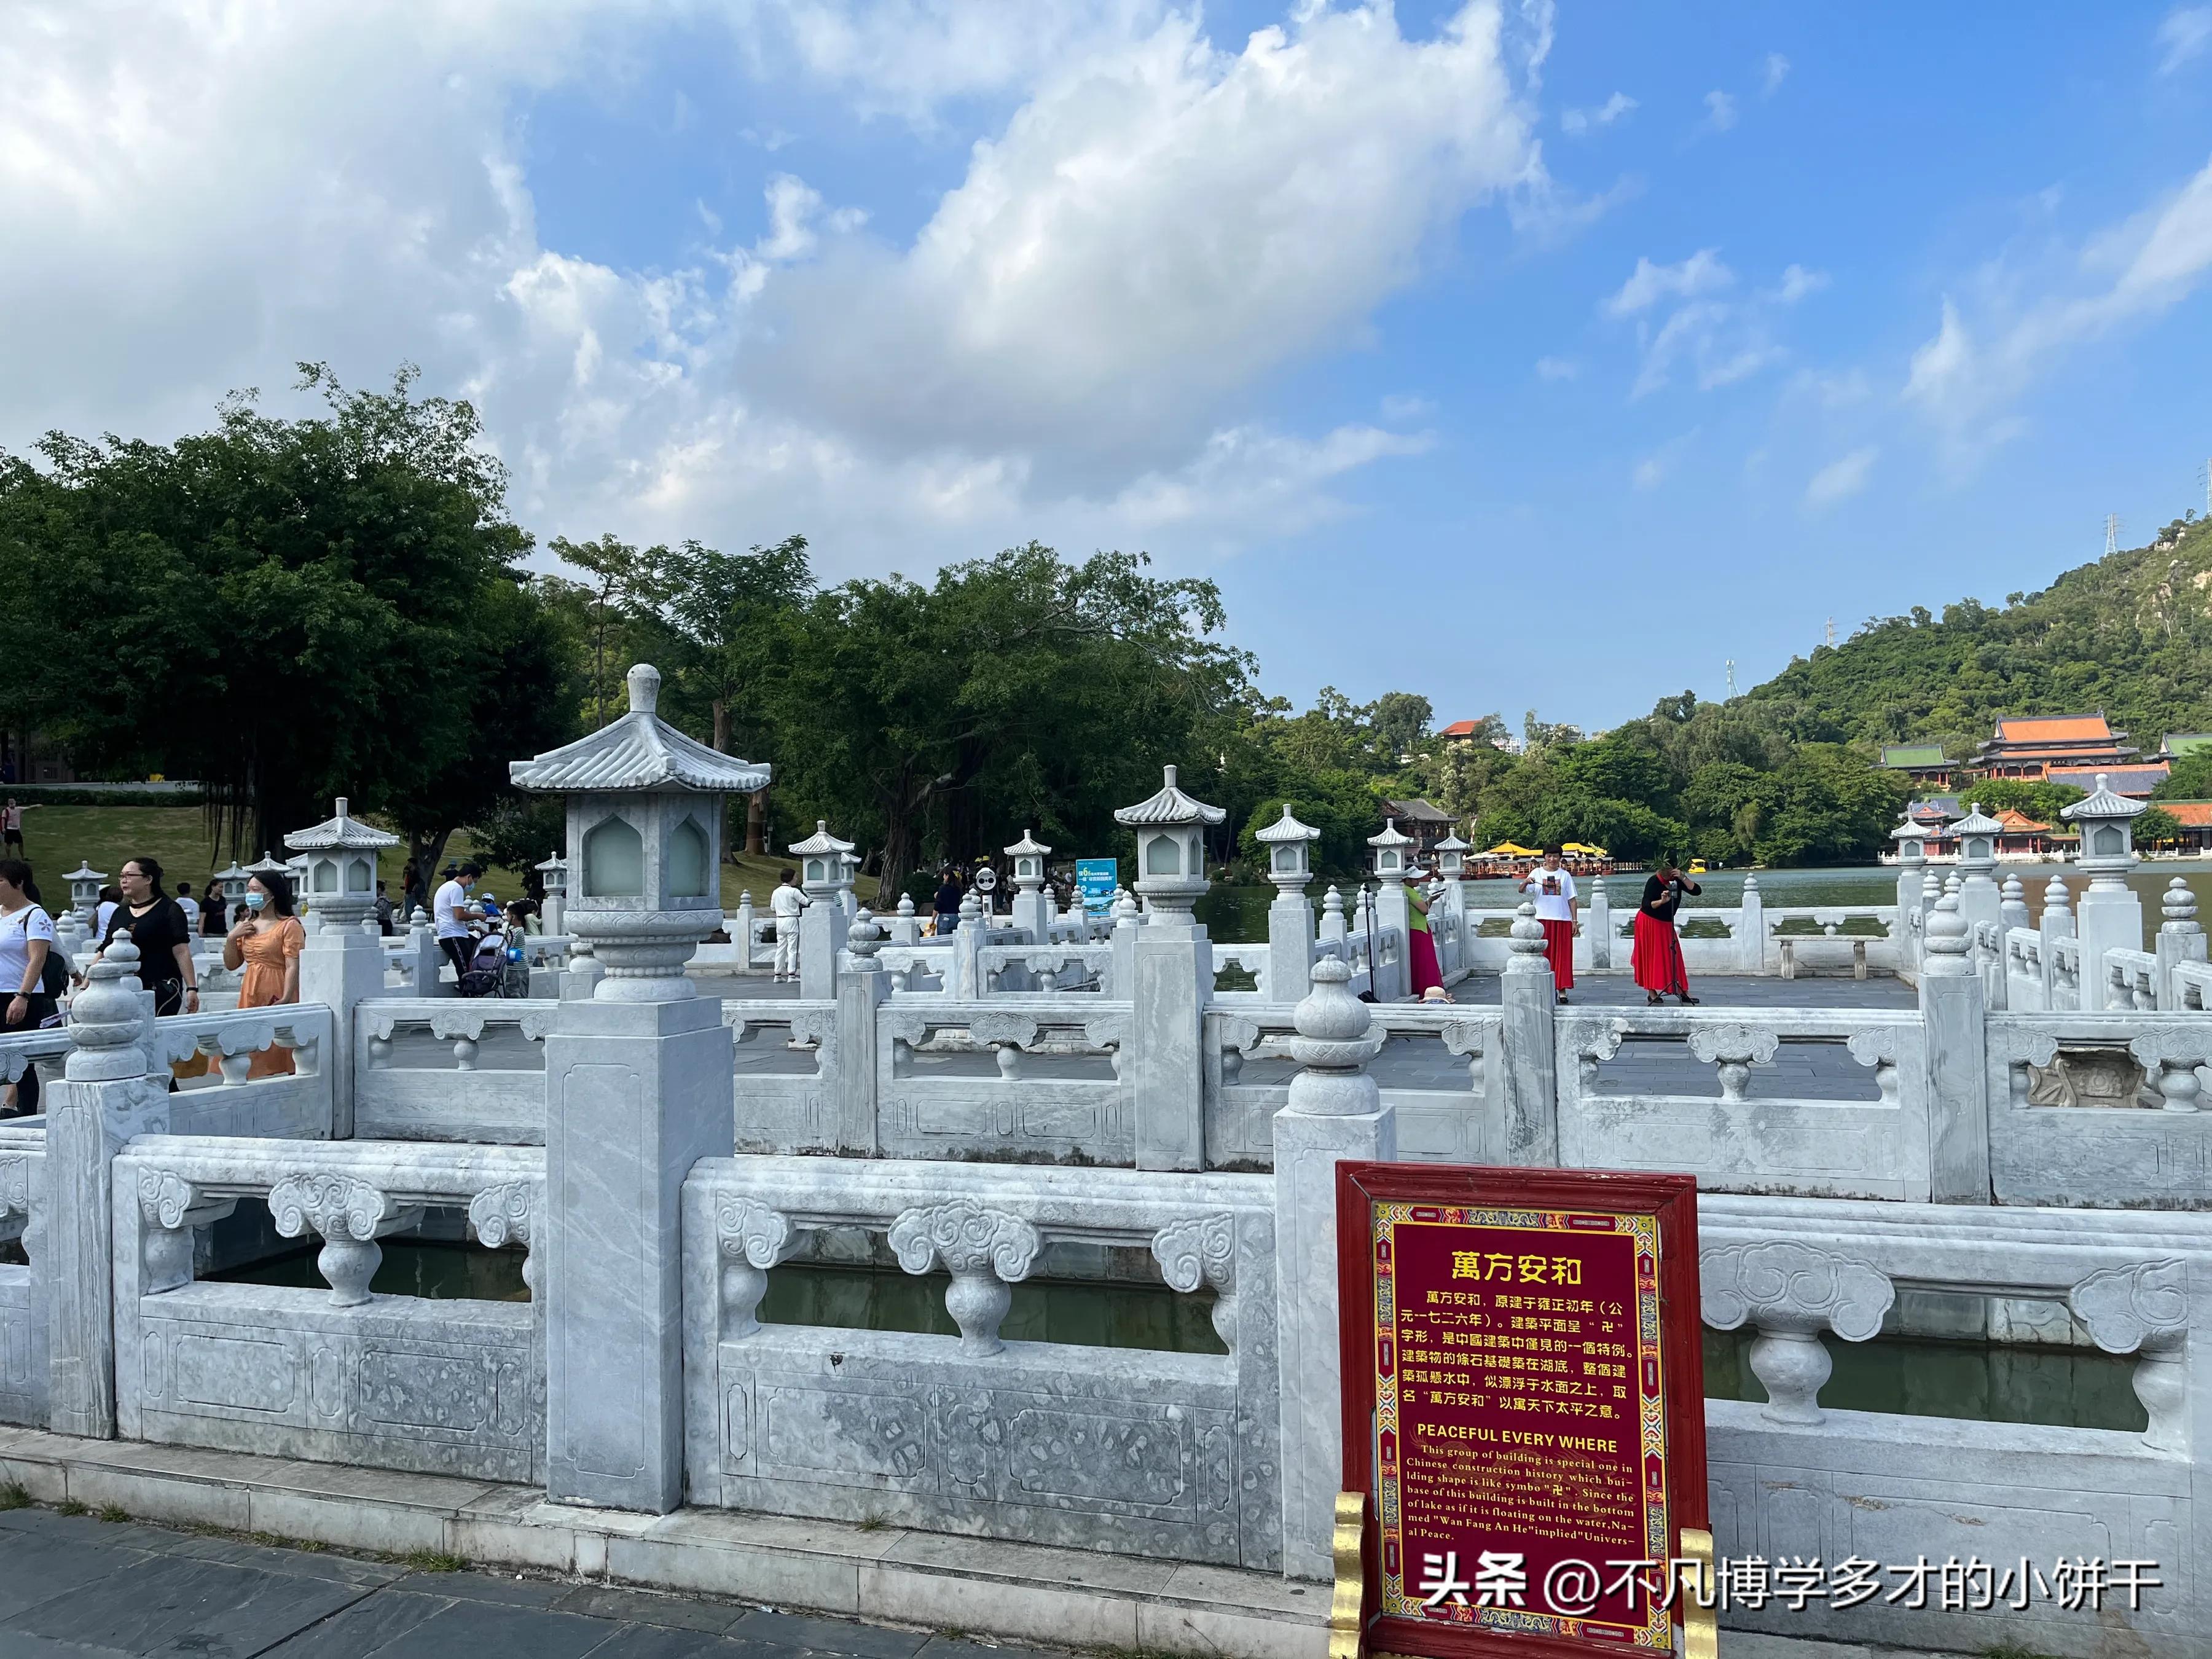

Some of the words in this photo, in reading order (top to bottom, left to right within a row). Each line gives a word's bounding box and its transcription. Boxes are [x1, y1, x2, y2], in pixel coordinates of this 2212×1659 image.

[1451, 1250, 1582, 1285] 萬方安和
[1418, 1423, 1498, 1441] PEACEFUL
[1502, 1430, 1555, 1446] EVERY
[1558, 1435, 1617, 1453] WHERE
[1406, 1457, 1447, 1469] Chinese
[1452, 1464, 1520, 1476] construction
[1526, 1468, 1564, 1482] history
[1569, 1473, 1602, 1484] which
[1421, 1445, 1444, 1454] This
[1447, 1449, 1478, 1460] group
[1496, 1451, 1542, 1466] building
[1545, 1456, 1553, 1465] is
[1557, 1459, 1594, 1469] special
[1622, 1464, 1633, 1473] in
[1406, 1471, 1433, 1483] lding
[1437, 1474, 1466, 1486] shape
[1470, 1477, 1478, 1486] is
[1482, 1478, 1502, 1488] like
[1505, 1482, 1540, 1492] symbo
[1582, 1488, 1612, 1500] Since
[1617, 1492, 1634, 1502] the
[1407, 1484, 1429, 1495] base
[1433, 1488, 1445, 1496] of
[1446, 1489, 1465, 1498] this
[1469, 1490, 1514, 1505] building
[1517, 1496, 1526, 1505] is
[1529, 1497, 1555, 1508] built
[1558, 1500, 1569, 1509] in
[1572, 1502, 1590, 1512] the
[1593, 1504, 1634, 1517] bottom
[1408, 1499, 1419, 1508] of
[1421, 1500, 1442, 1510] lake
[1459, 1504, 1468, 1512] if
[1470, 1505, 1477, 1513] it
[1481, 1506, 1489, 1515] is
[1492, 1507, 1535, 1522] floating
[1555, 1515, 1572, 1524] the
[1408, 1514, 1430, 1523] med
[1433, 1515, 1462, 1526] "Wan
[1466, 1518, 1491, 1531] Fang
[1495, 1522, 1509, 1531] An
[1408, 1528, 1417, 1536] al
[1421, 1528, 1454, 1540] Peace.
